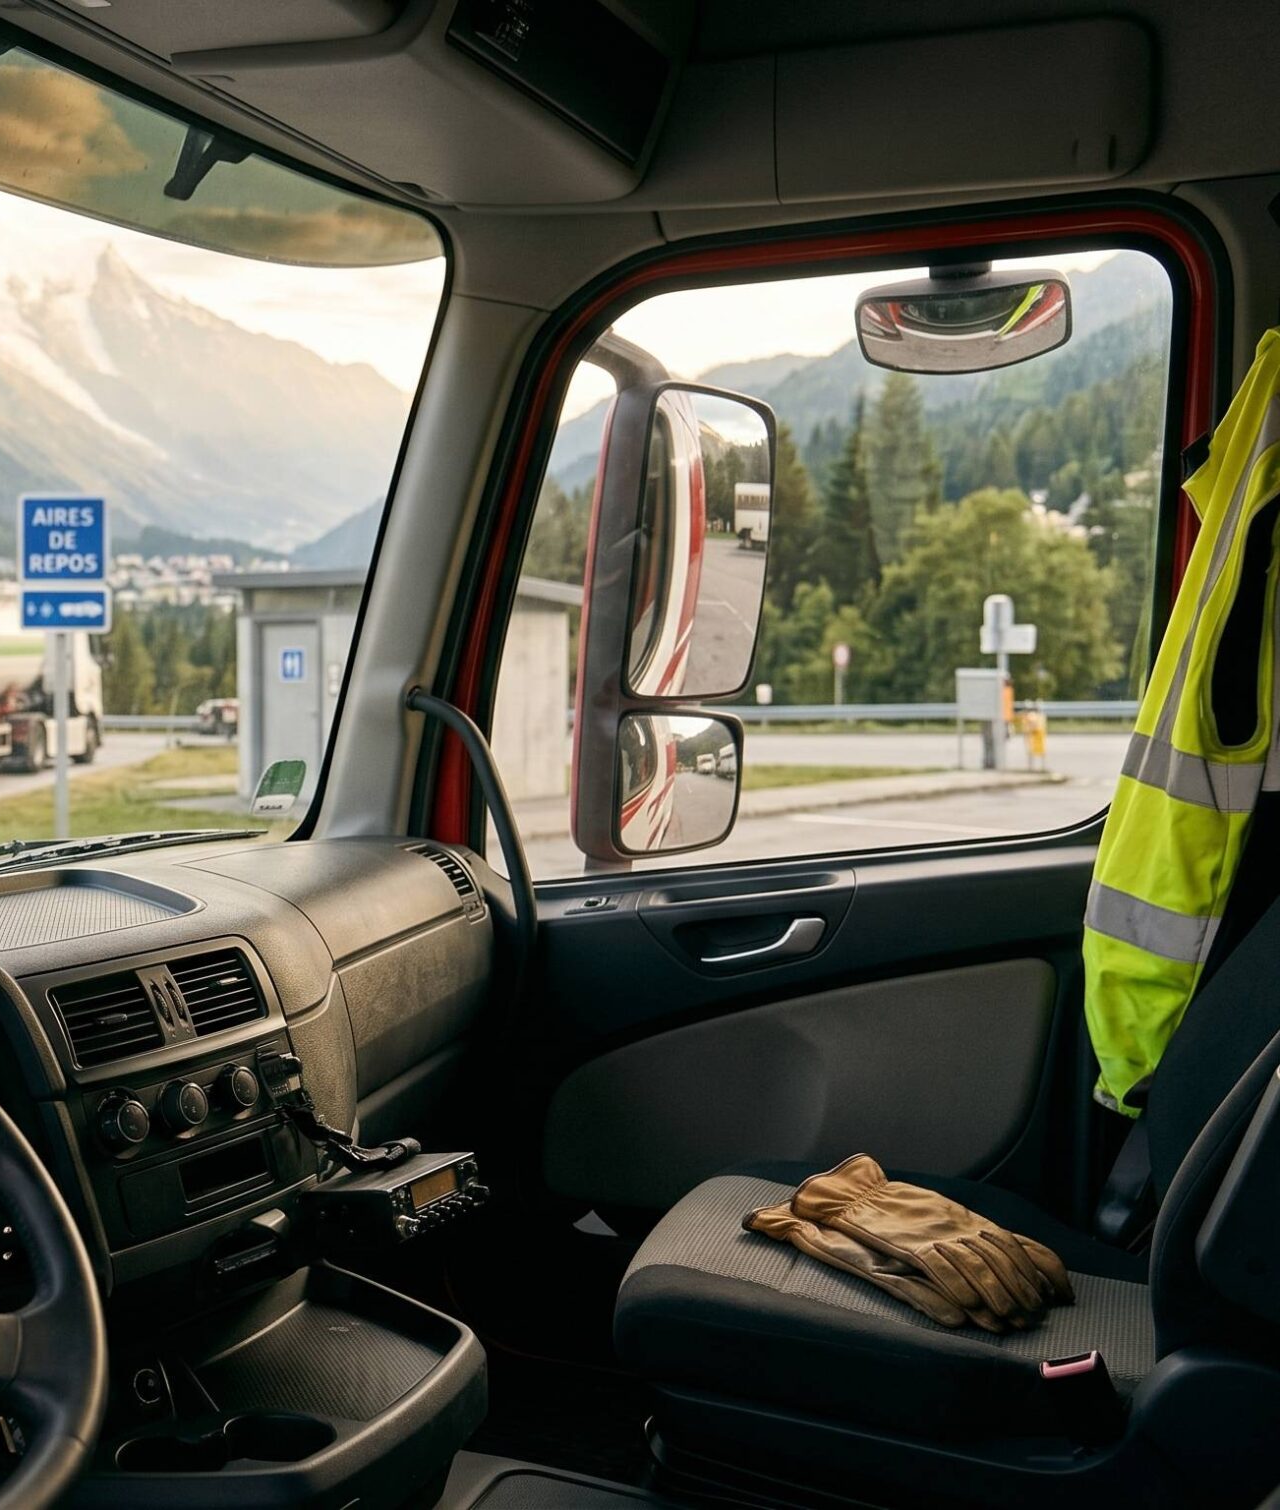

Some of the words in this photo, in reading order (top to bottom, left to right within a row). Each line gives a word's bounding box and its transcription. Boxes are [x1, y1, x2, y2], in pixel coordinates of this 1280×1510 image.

[32, 507, 94, 527] AIRES
[48, 530, 77, 550] DE
[29, 553, 98, 573] REPOS
